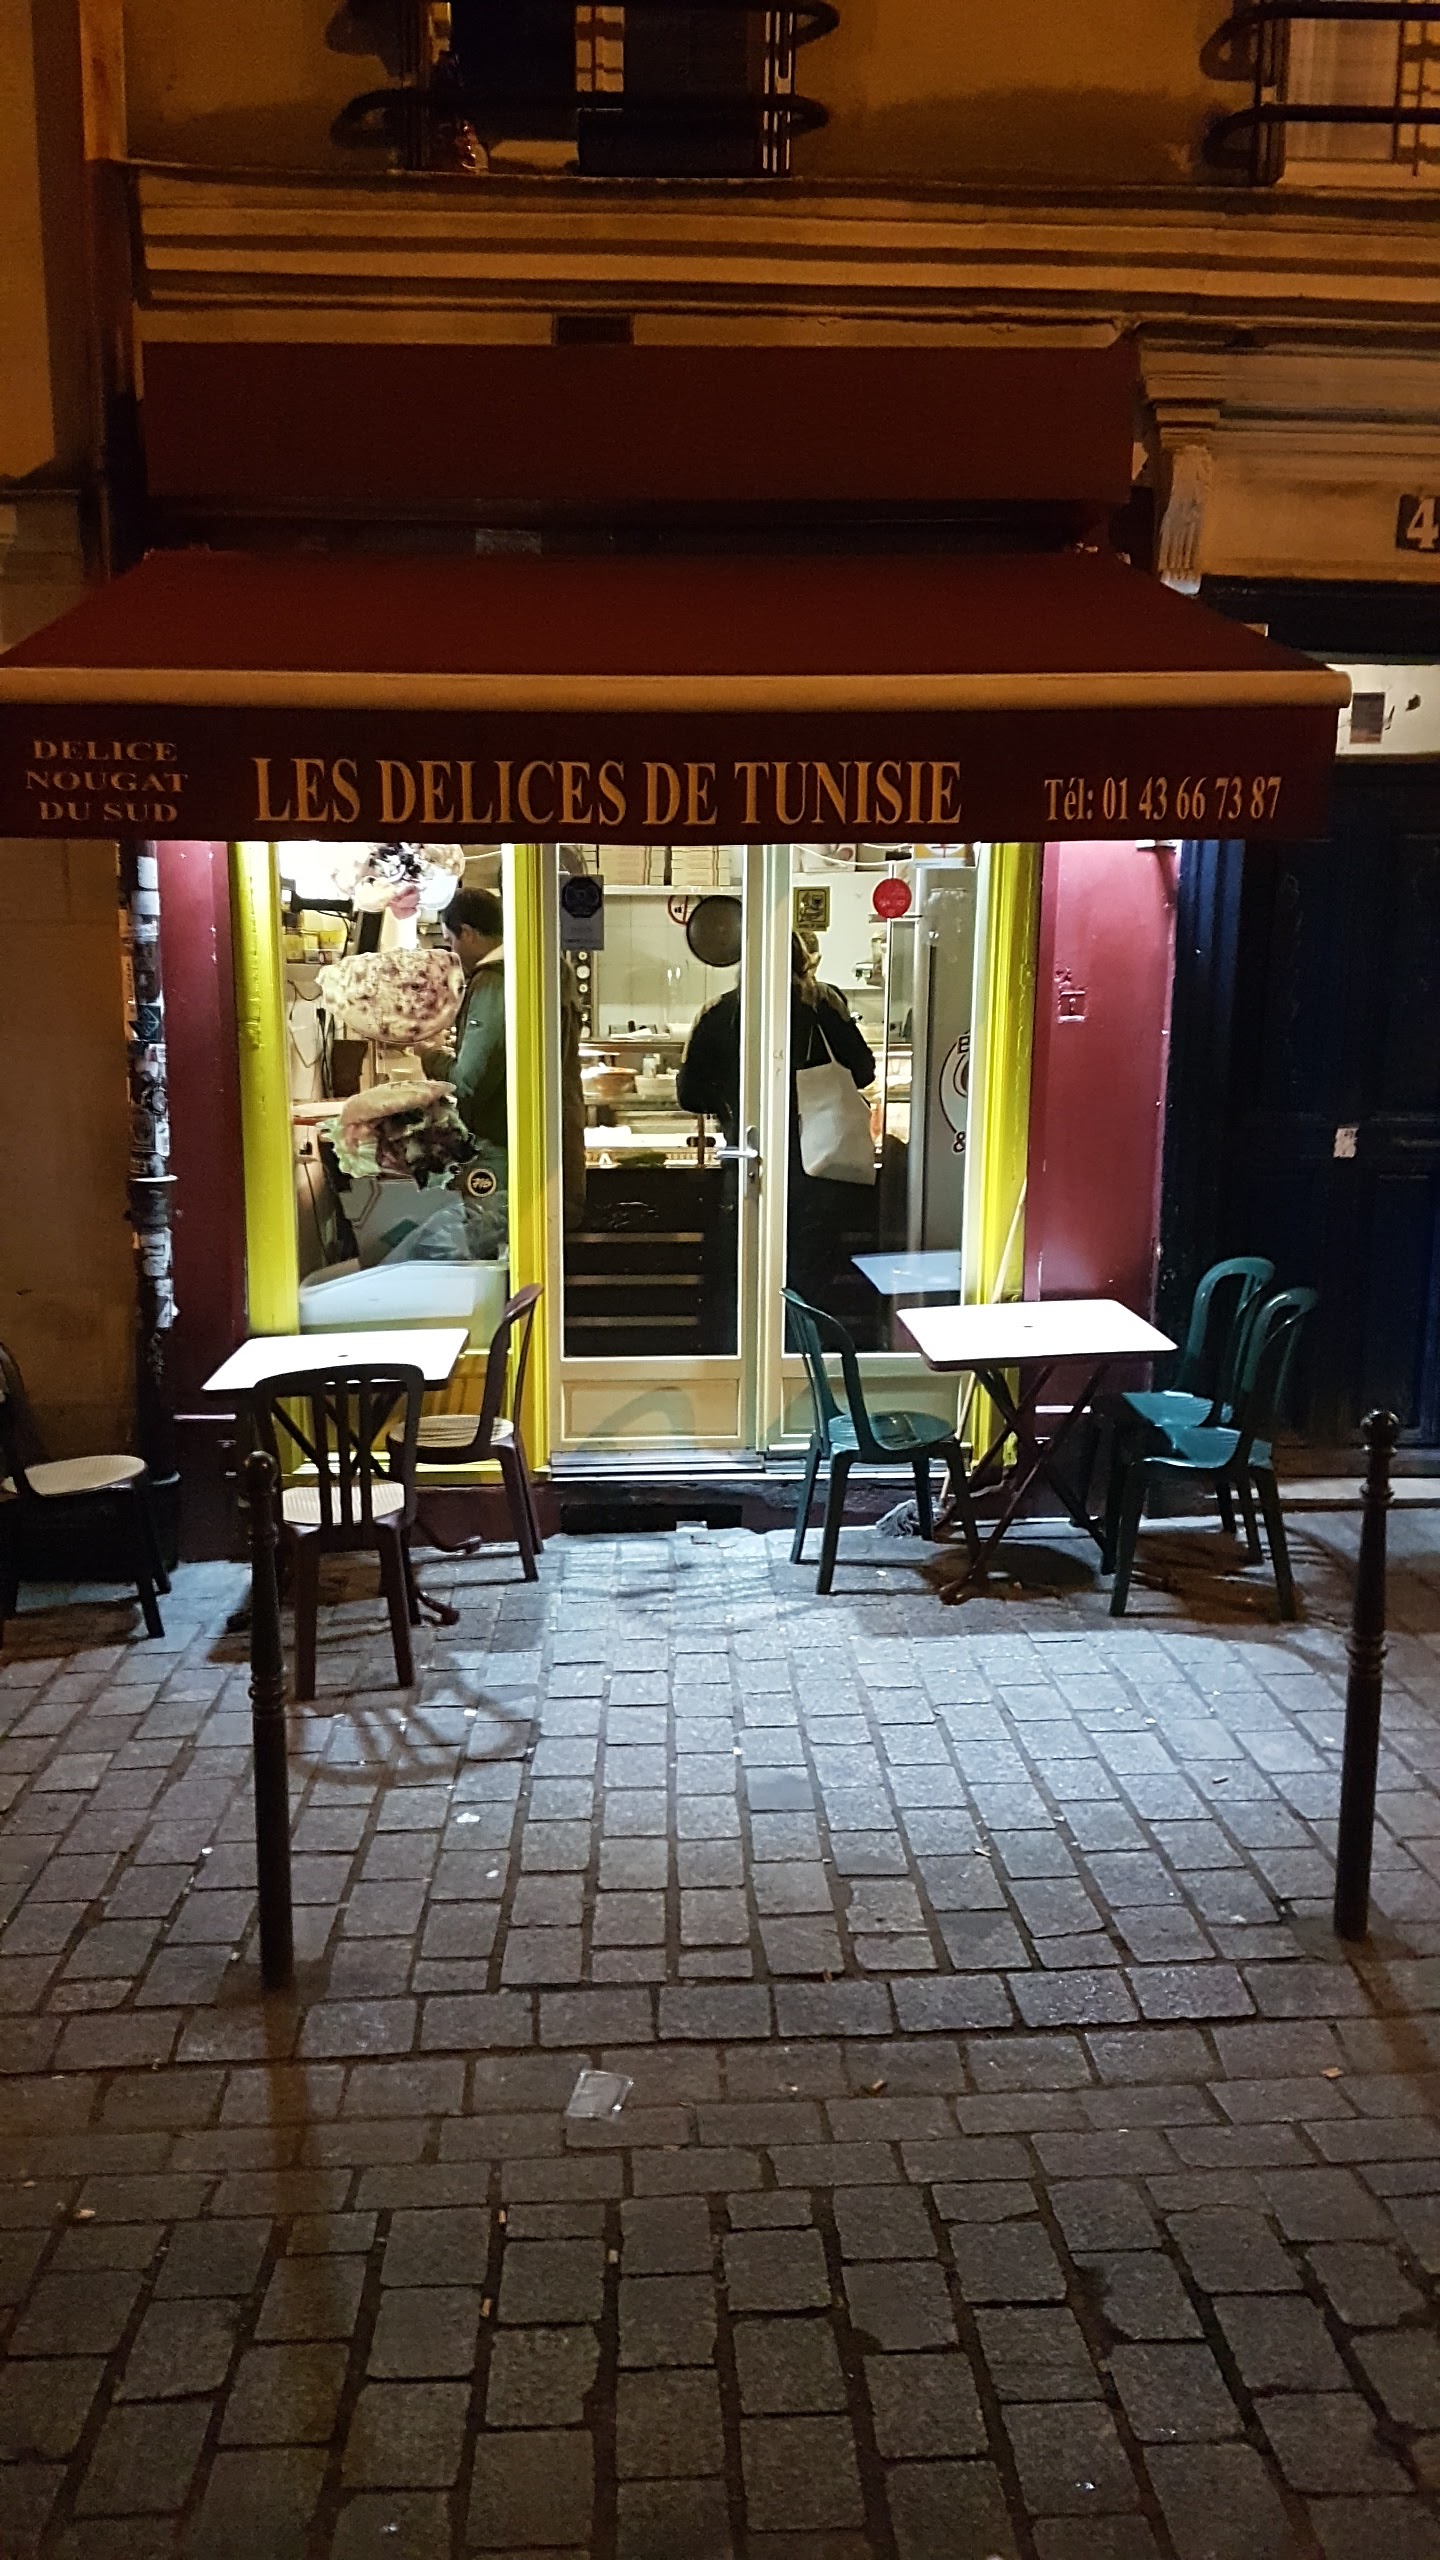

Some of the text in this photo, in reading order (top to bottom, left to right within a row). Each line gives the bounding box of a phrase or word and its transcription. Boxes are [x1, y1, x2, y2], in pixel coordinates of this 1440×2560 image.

[33, 740, 178, 761] DELICE
[26, 770, 189, 792] NOUGAT
[250, 757, 962, 826] LES DELICES DE TUNISIE
[1043, 775, 1282, 821] Tél: 01 43 66 73 87
[39, 800, 178, 822] DU SUD
